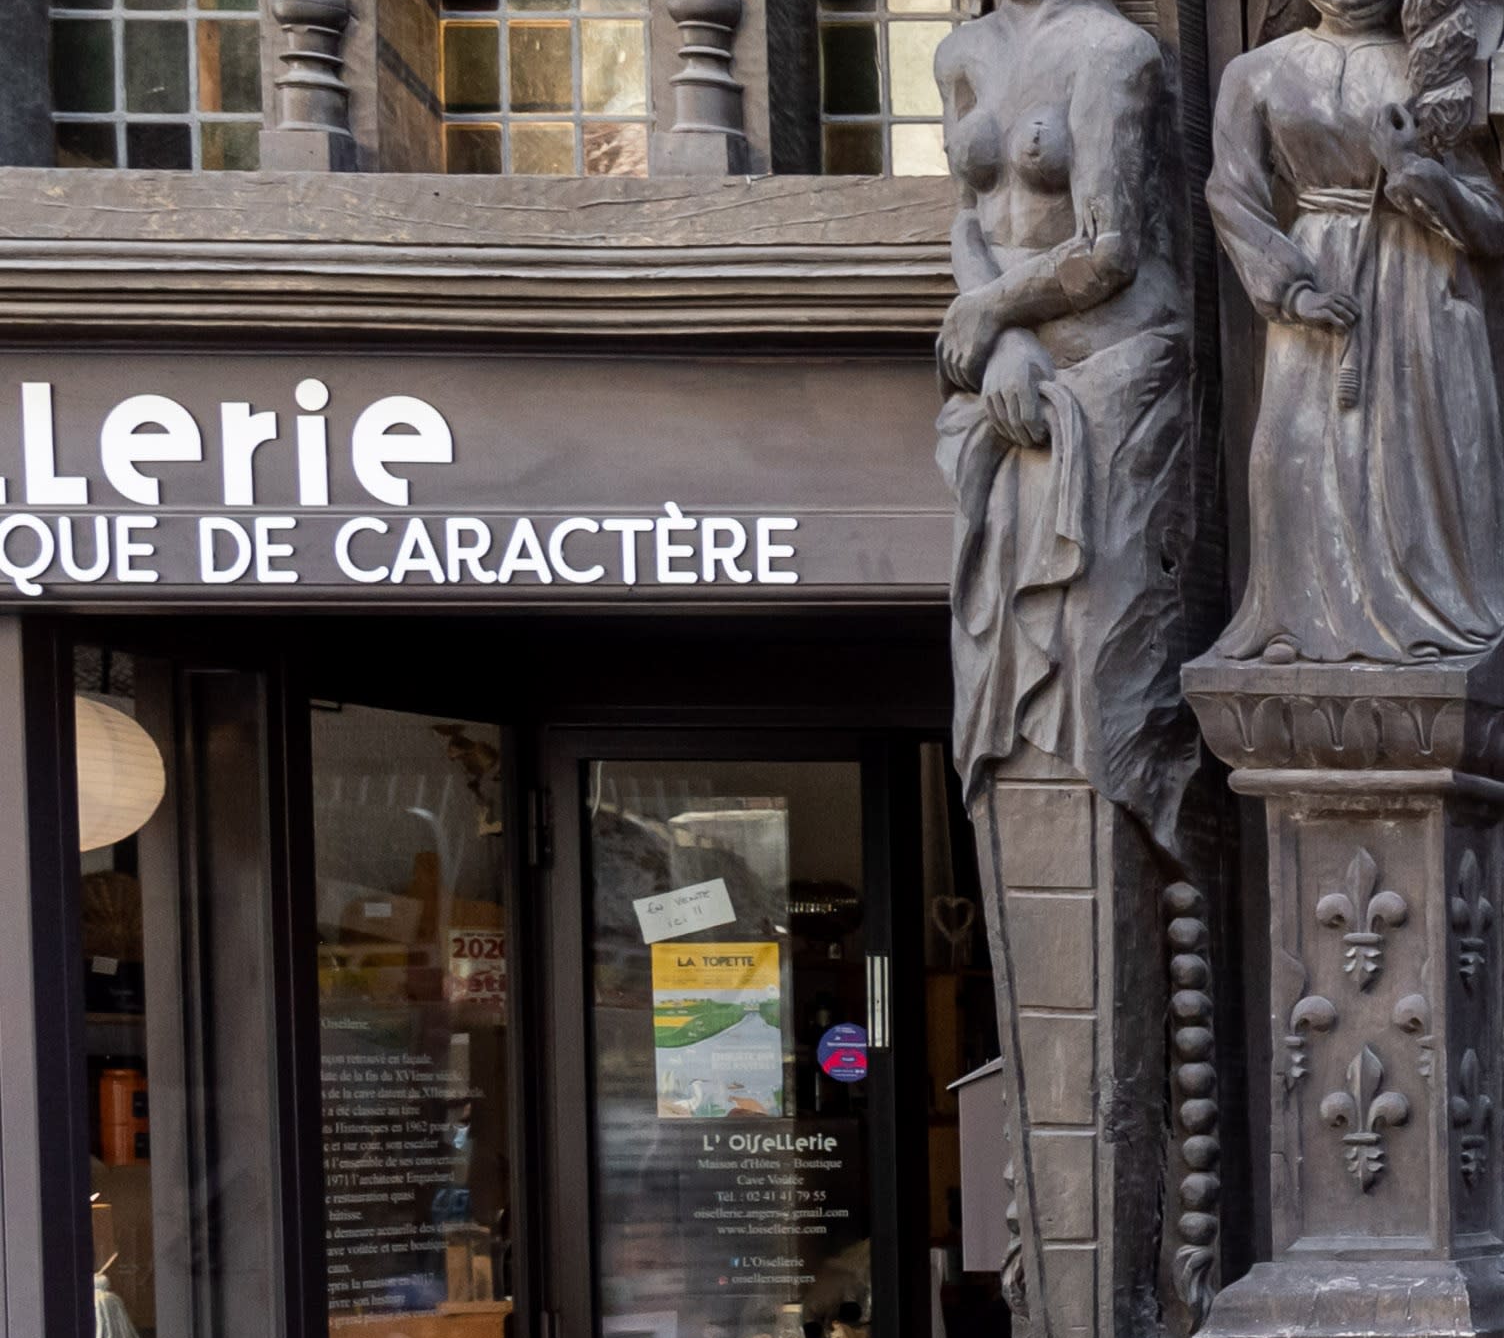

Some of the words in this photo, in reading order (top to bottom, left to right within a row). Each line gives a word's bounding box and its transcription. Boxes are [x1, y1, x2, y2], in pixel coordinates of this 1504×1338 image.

[200, 515, 299, 584] DE
[335, 501, 800, 585] CARACTÈRE
[747, 1191, 760, 1202] 02
[763, 1191, 776, 1202] 41
[779, 1191, 792, 1202] 41
[813, 1191, 826, 1202] 55
